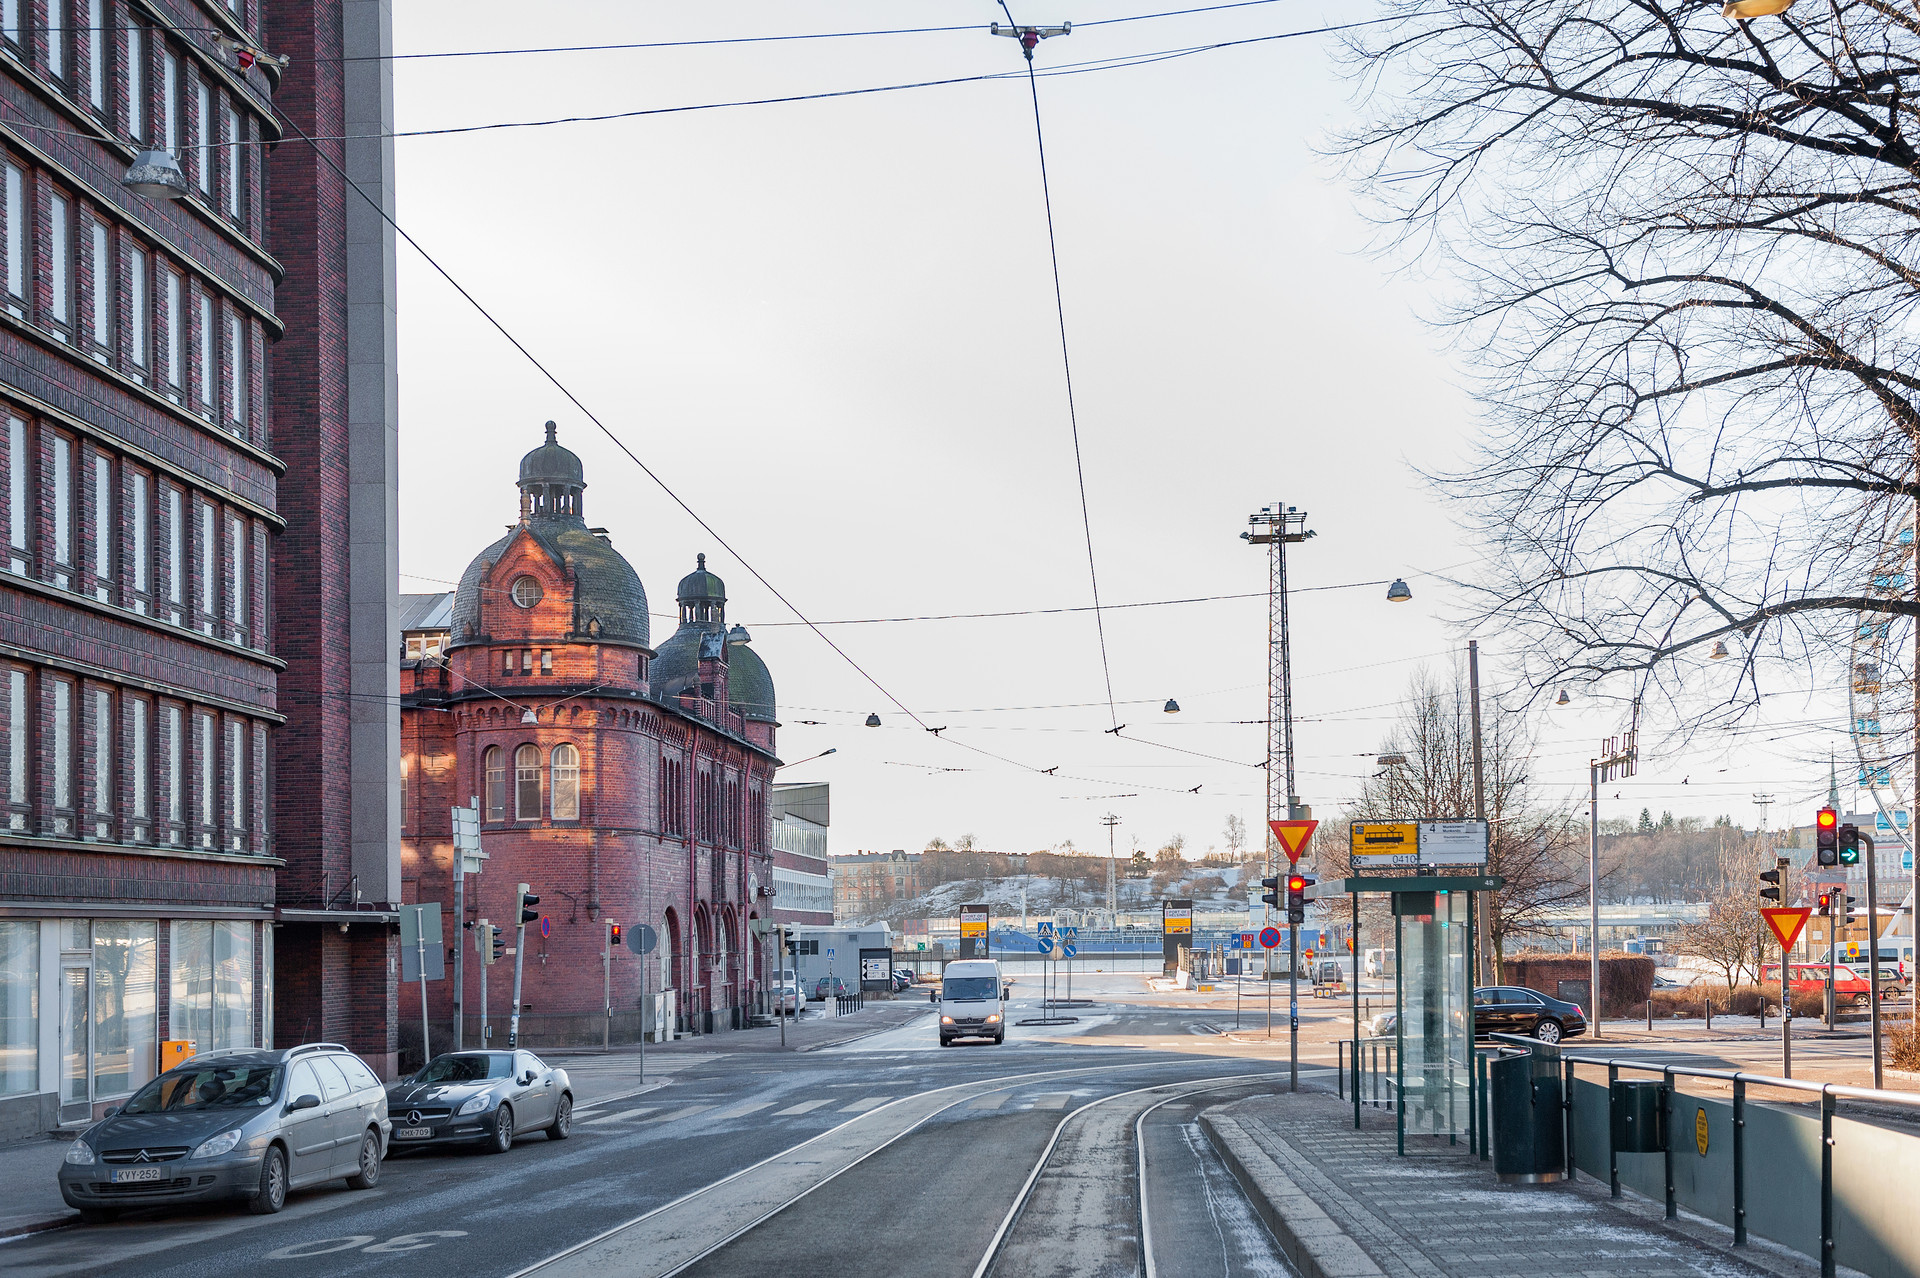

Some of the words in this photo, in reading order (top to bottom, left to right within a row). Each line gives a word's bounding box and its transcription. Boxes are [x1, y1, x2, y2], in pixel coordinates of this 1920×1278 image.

[1429, 824, 1436, 833] 4
[1392, 855, 1416, 864] 0410
[118, 1170, 158, 1181] KVY-252
